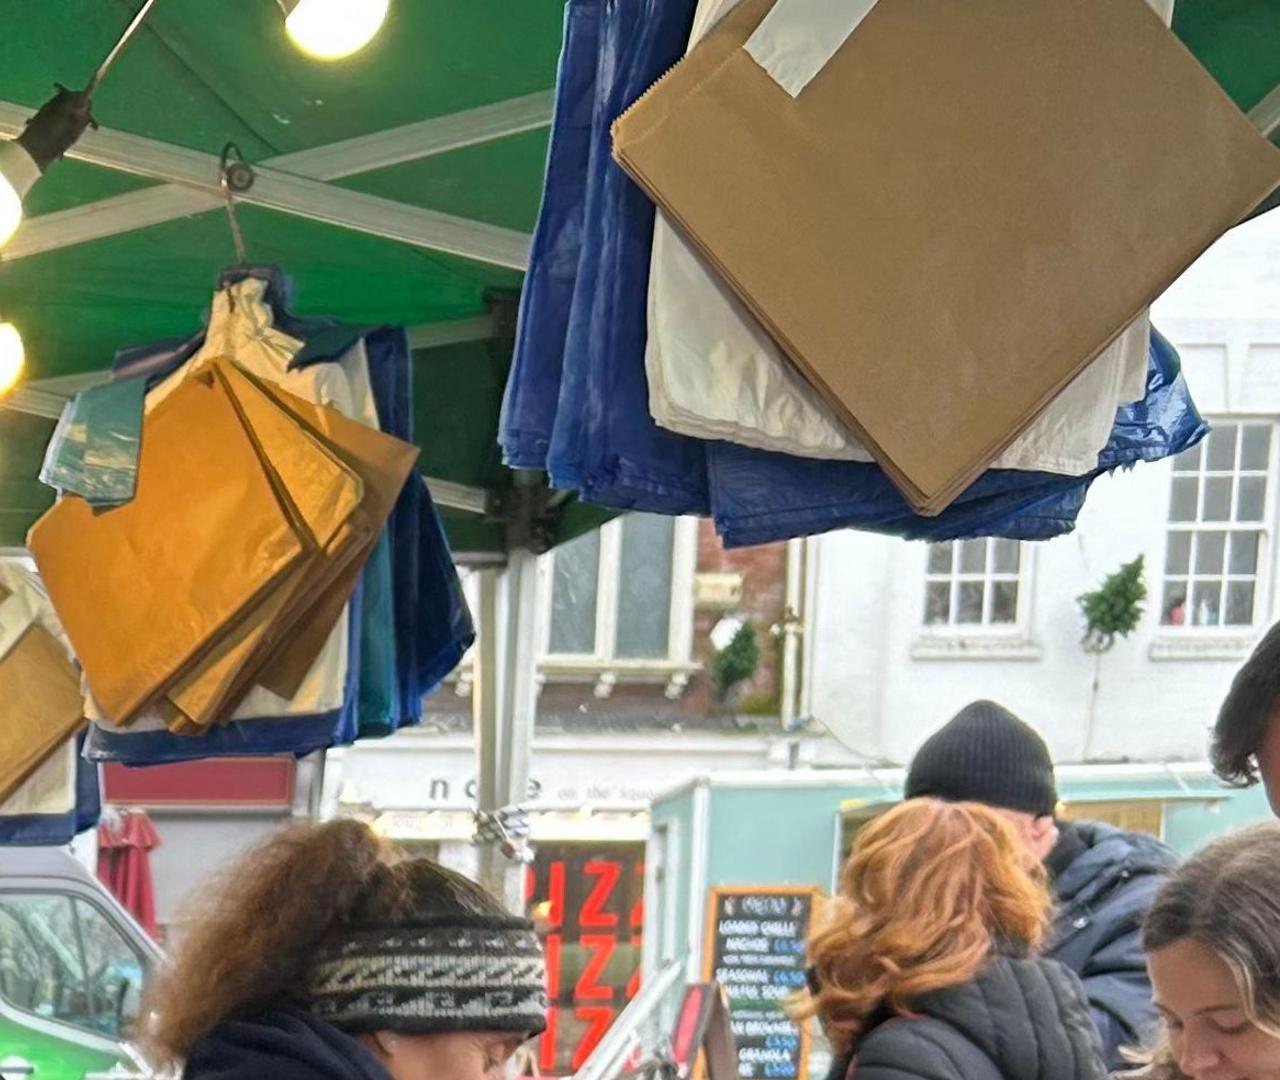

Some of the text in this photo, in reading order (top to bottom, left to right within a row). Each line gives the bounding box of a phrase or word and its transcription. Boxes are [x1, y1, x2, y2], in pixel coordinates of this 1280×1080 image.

[719, 920, 760, 936] LOADED
[716, 967, 769, 983] SEASONAL
[738, 1047, 791, 1063] GRANOLA
